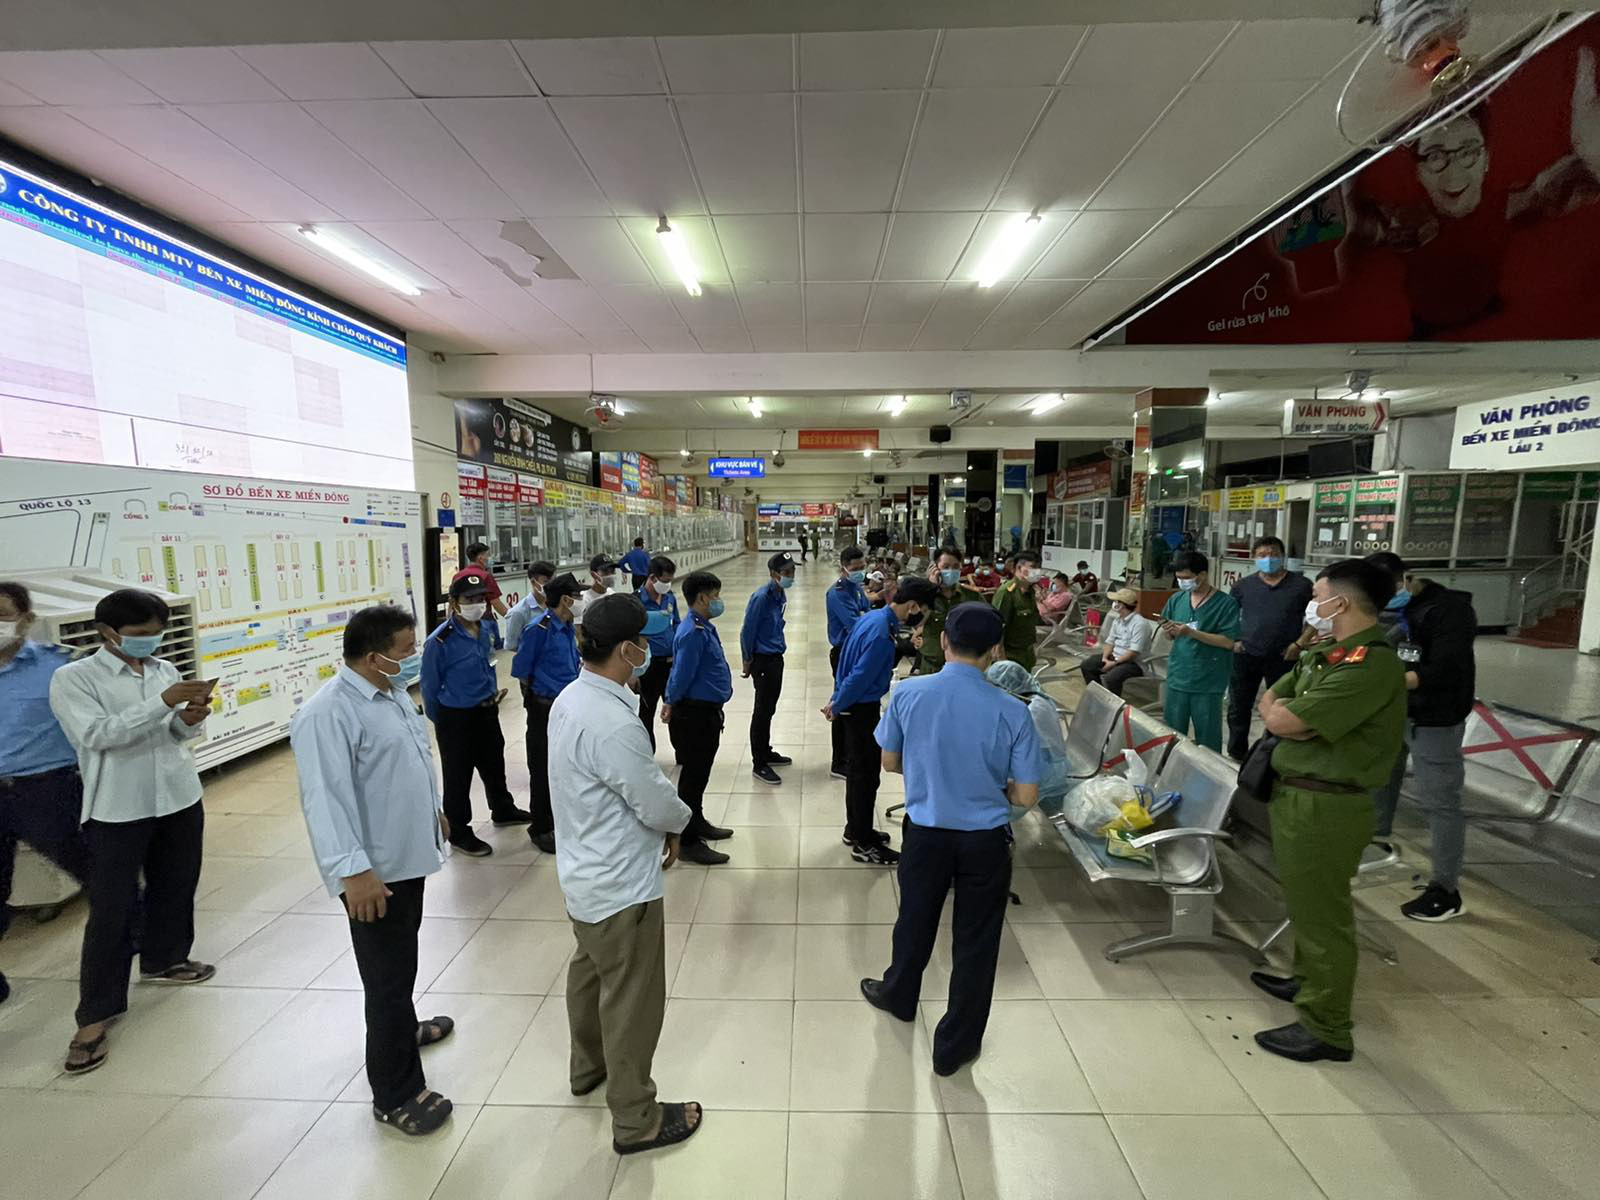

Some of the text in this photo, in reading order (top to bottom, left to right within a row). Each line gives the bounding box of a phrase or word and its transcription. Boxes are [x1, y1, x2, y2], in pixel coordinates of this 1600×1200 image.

[18, 189, 80, 222] CÔNG
[81, 215, 107, 234] TY
[111, 227, 159, 256] TNHH
[161, 248, 194, 269] MTV
[197, 263, 224, 282] BẾN
[226, 275, 243, 290] XE
[276, 297, 305, 316] ĐÔNG
[331, 321, 355, 337] CHÀO
[1208, 318, 1226, 332] Gel
[1247, 312, 1266, 325] tay
[1298, 403, 1366, 418] VĂN PHÒNG
[1480, 396, 1590, 425] VĂN PHÒNG
[1462, 429, 1487, 446] BẾN
[1491, 430, 1510, 442] XE
[1535, 442, 1544, 451] 2
[203, 483, 221, 495] SƠ
[225, 483, 244, 496] ĐỒ
[248, 485, 273, 498] BẾN
[277, 490, 292, 499] XE
[19, 498, 92, 510] QUỐC LỘ 13
